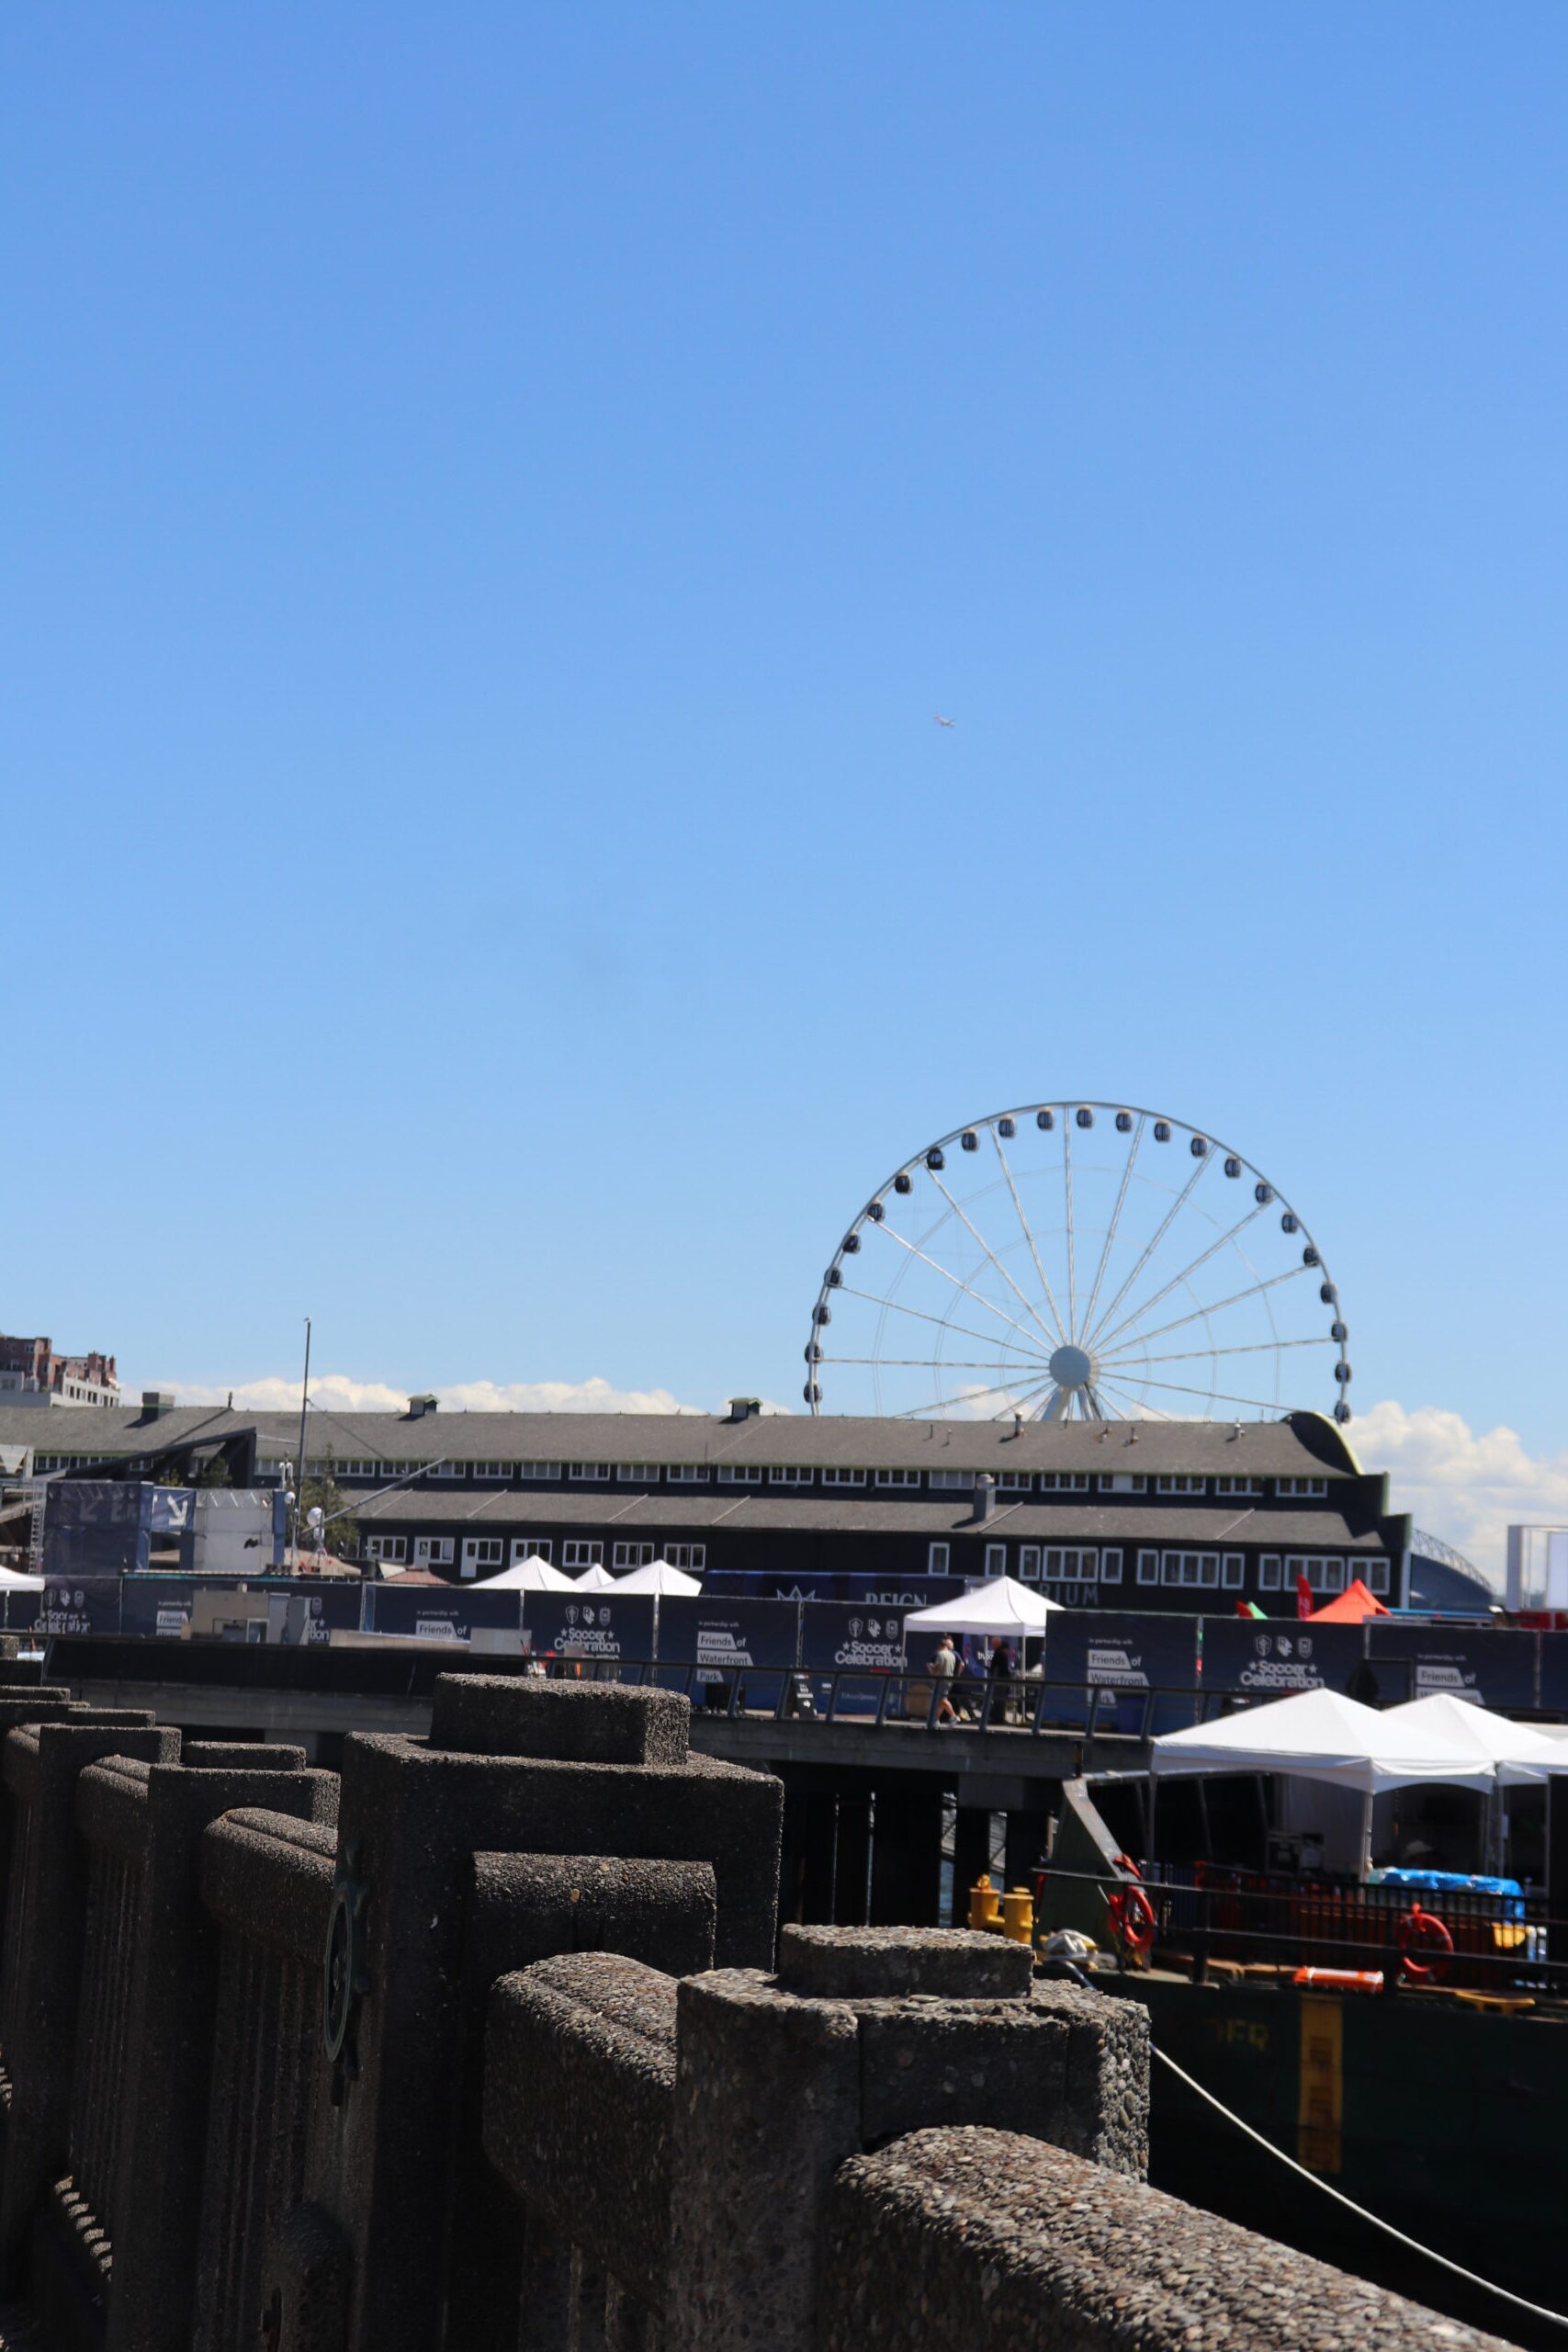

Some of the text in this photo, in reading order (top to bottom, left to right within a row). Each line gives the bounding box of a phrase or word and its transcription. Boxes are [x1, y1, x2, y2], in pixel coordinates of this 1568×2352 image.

[419, 1624, 467, 1635] Friends of
[569, 1628, 606, 1640] Soccer
[700, 1636, 747, 1647] Friends of
[851, 1640, 894, 1654] Soccer
[700, 1654, 748, 1665] Waterfront
[835, 1651, 908, 1667] Celebration
[1092, 1655, 1142, 1667] Friends of
[1258, 1660, 1308, 1674] Soccer
[700, 1672, 718, 1681] Park
[1091, 1675, 1144, 1687] Waterfront
[1240, 1671, 1325, 1689] Celebration
[1421, 1671, 1477, 1684] Friends of
